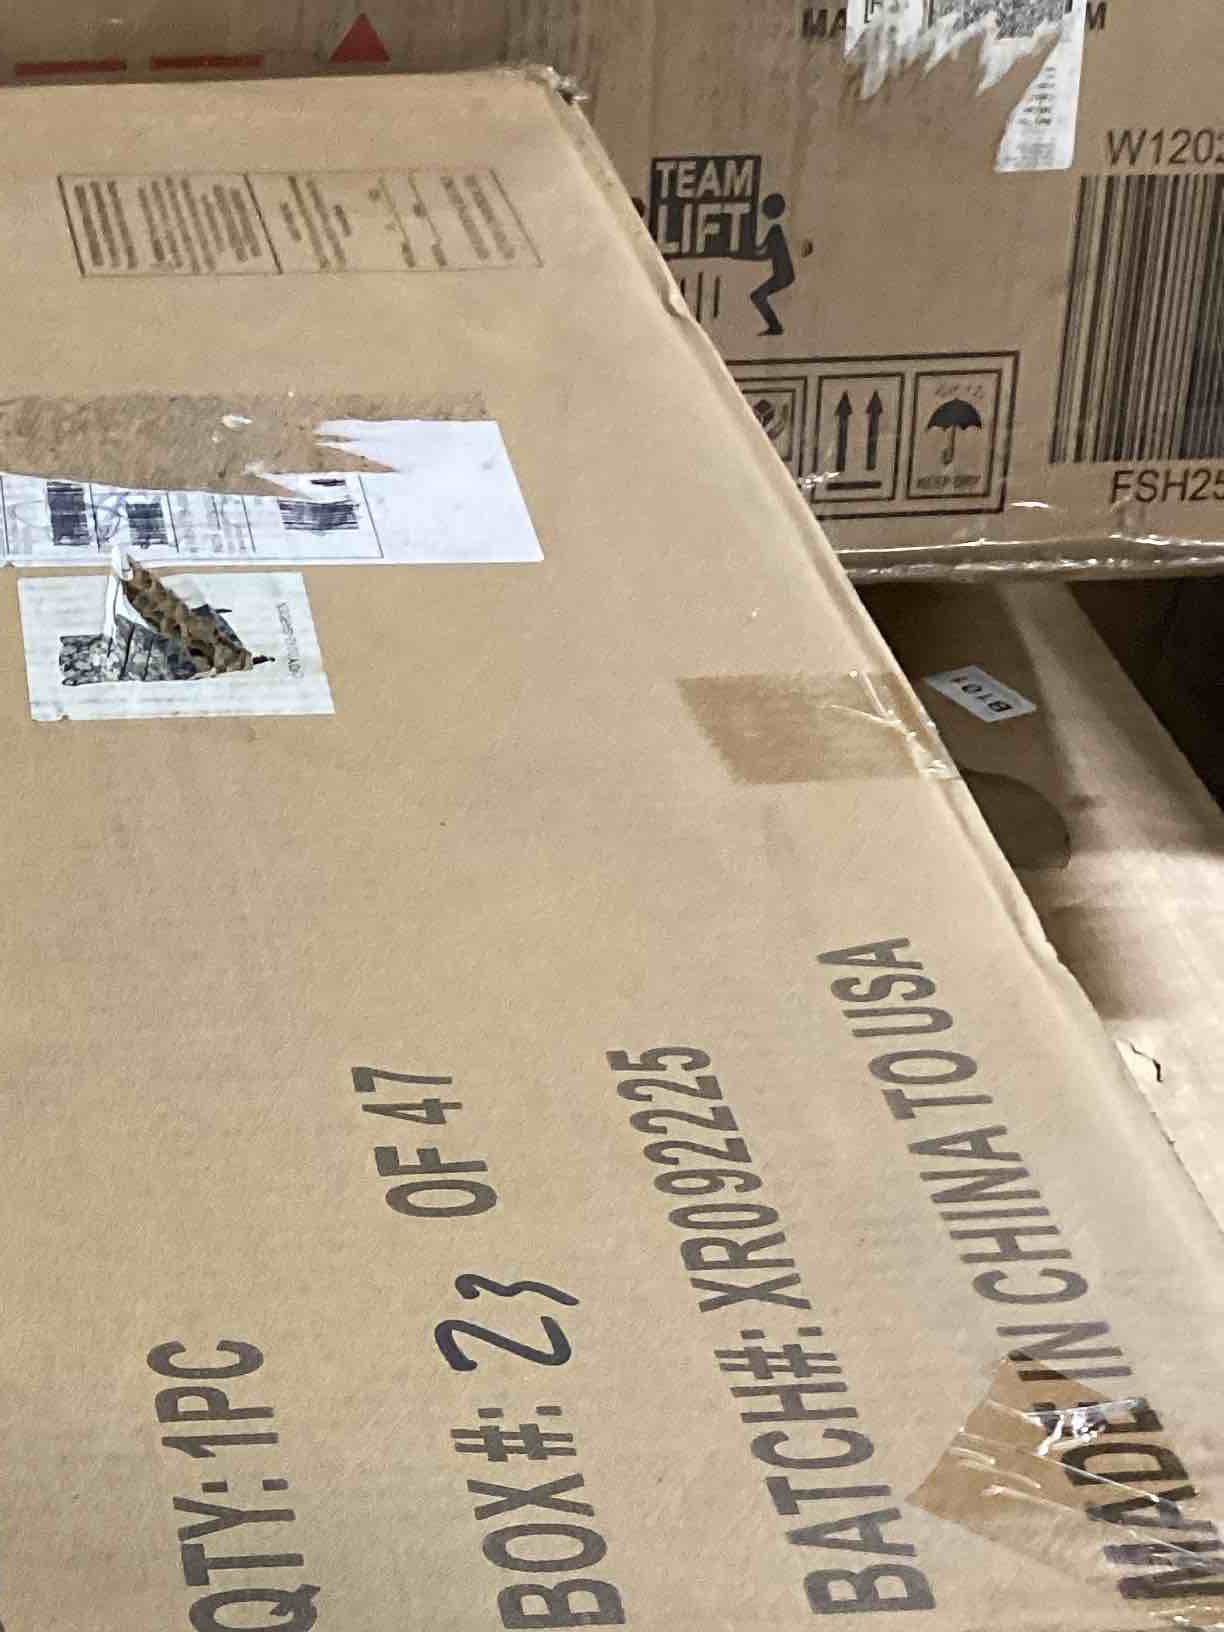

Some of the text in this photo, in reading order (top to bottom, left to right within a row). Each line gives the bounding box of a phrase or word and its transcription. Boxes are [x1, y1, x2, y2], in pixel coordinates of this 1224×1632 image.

[656, 158, 754, 199] TEAM
[657, 202, 751, 254] LIFT
[817, 937, 954, 1039] USA
[868, 1048, 995, 1121] TO
[351, 1066, 499, 1218] OF 47
[606, 1045, 812, 1312] XR09225
[907, 1124, 1089, 1305] CHINA
[434, 1273, 579, 1372] 23
[996, 1321, 1132, 1382] IN
[146, 1339, 280, 1459] 1PC
